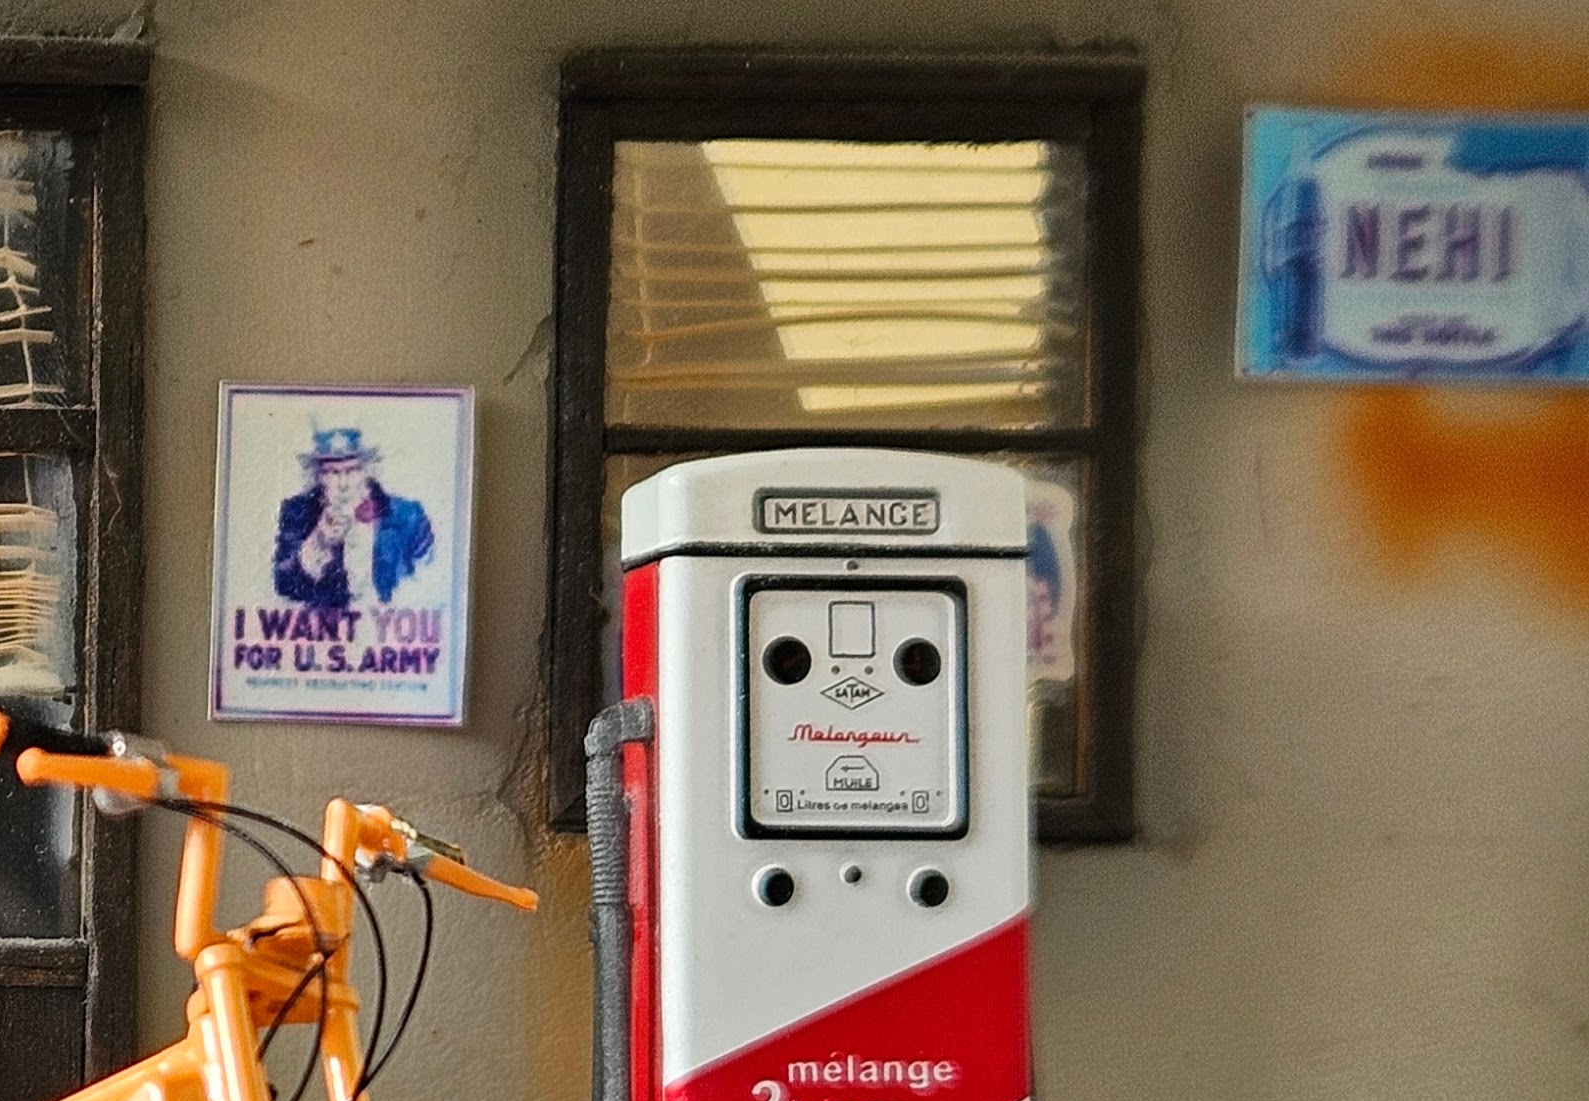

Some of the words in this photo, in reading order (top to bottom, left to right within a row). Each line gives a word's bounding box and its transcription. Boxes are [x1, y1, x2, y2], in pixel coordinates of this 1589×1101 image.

[1340, 203, 1516, 283] NEHI
[774, 502, 929, 526] MELANGE
[234, 608, 245, 641] I
[259, 608, 361, 643] WANT
[371, 607, 443, 644] YOU
[234, 643, 282, 671] FOR
[788, 1052, 954, 1088] mélange
